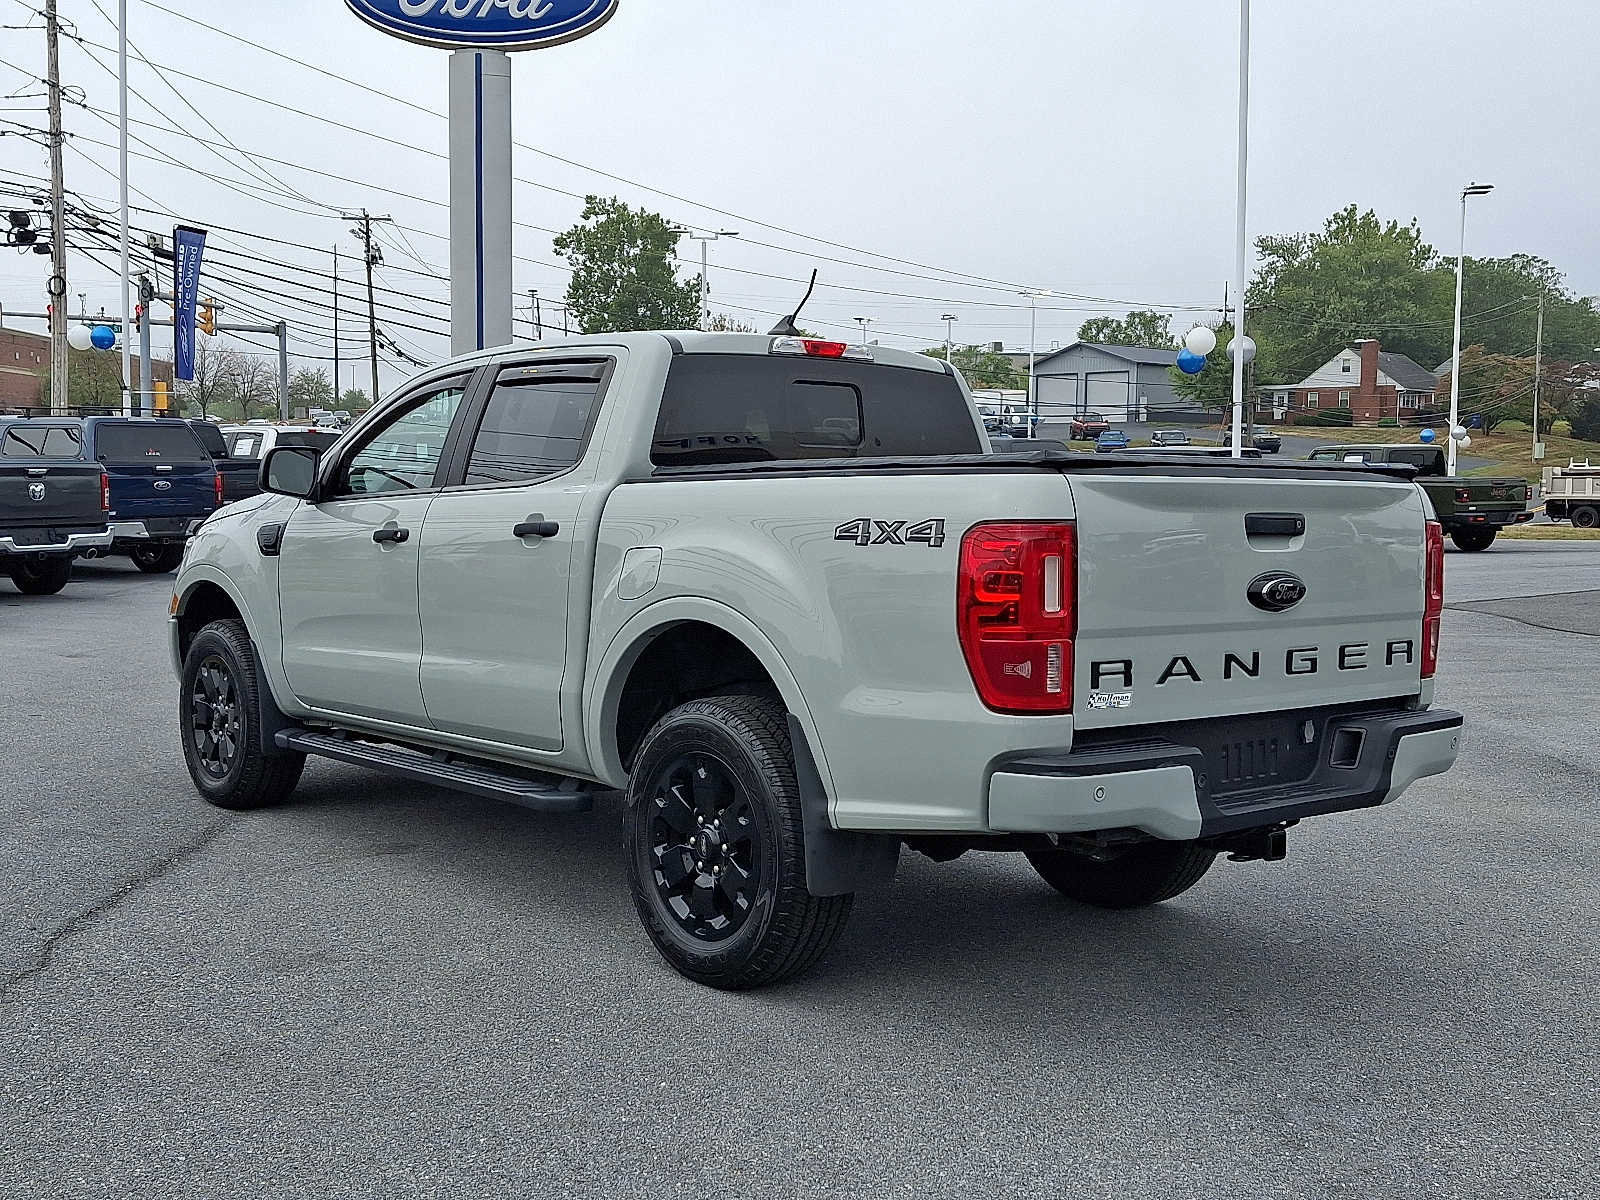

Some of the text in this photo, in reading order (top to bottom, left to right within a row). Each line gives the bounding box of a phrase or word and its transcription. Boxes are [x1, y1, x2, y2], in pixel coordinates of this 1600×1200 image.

[183, 246, 198, 310] Pre-Owned
[1276, 583, 1300, 600] Ford
[1090, 639, 1413, 689] RANGER
